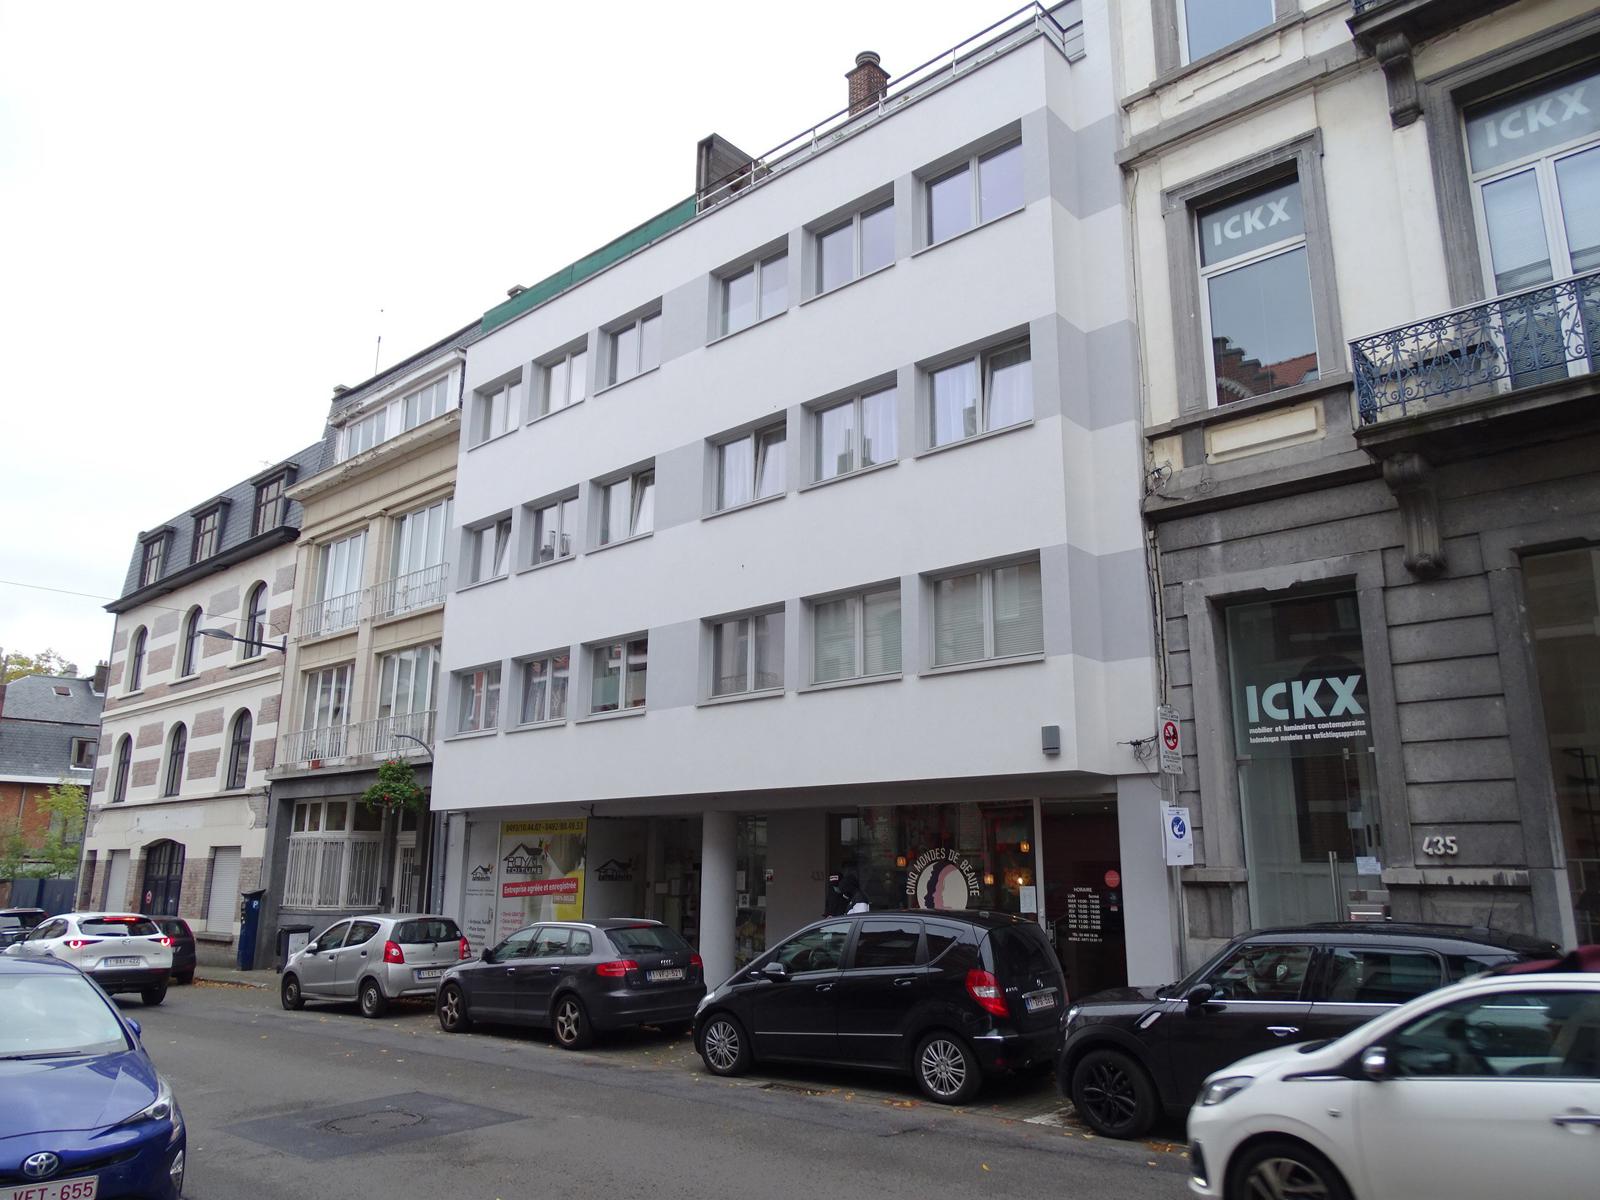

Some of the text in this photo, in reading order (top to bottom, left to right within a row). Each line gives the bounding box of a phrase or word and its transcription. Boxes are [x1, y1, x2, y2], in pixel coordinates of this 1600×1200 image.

[1485, 85, 1591, 149] ICKX
[1213, 196, 1291, 247] ICKX
[1246, 675, 1366, 723] ICKX
[1249, 726, 1273, 734] mobilier
[1283, 722, 1316, 732] luminaires
[1318, 720, 1366, 730] contemporains
[1422, 836, 1458, 855] 435
[504, 885, 527, 895] Entreprise
[527, 883, 543, 893] agréée
[543, 883, 549, 891] et
[549, 880, 577, 892] enregistrée
[906, 871, 919, 895] CINQ
[913, 847, 946, 872] MONDES
[947, 849, 961, 864] DE
